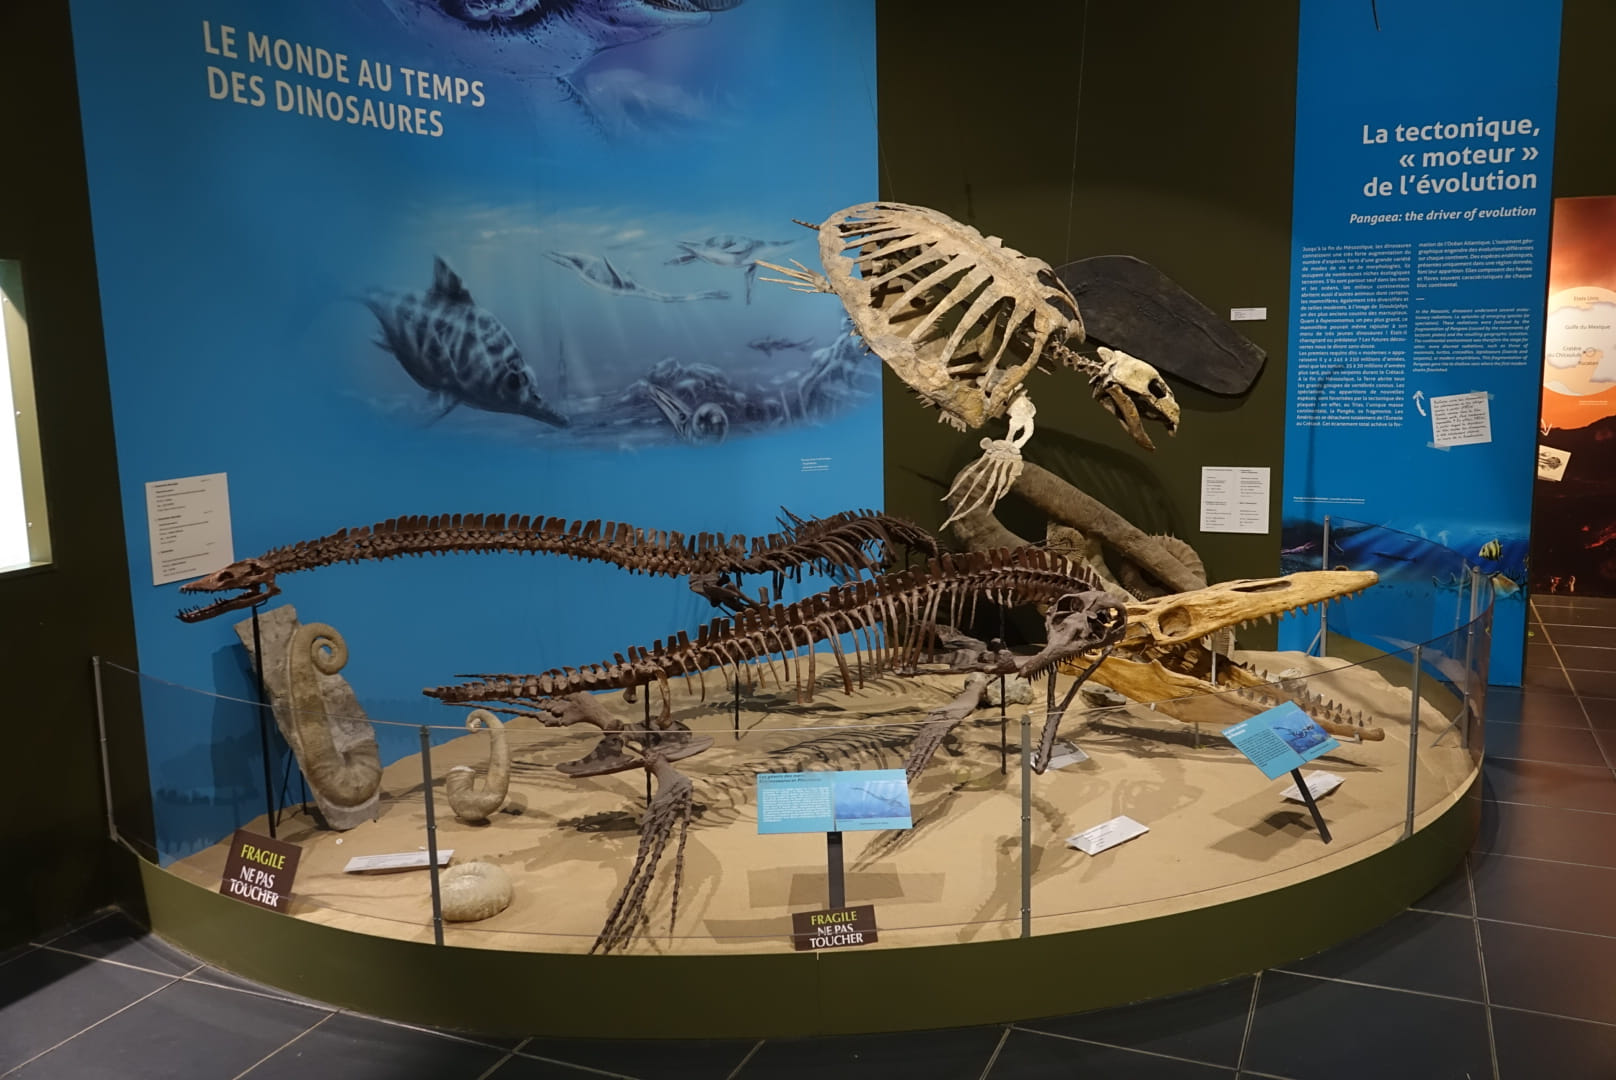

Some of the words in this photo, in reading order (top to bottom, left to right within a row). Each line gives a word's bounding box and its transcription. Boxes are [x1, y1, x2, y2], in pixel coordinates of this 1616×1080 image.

[202, 20, 238, 59] LE
[248, 31, 350, 83] MONDE
[359, 61, 392, 91] AU
[400, 69, 485, 107] TEMPS
[207, 66, 266, 107] DES
[275, 79, 443, 137] DINOSAURES
[1363, 124, 1388, 145] La
[1395, 116, 1540, 143] tectonique,
[1422, 147, 1516, 168] moteur
[1363, 176, 1393, 197] de
[1400, 169, 1537, 195] l'évolution
[1349, 213, 1402, 226] Pangaea:
[1405, 211, 1424, 221] the
[1426, 210, 1462, 220] driver
[1463, 208, 1478, 221] of
[1478, 206, 1537, 218] evolution
[240, 843, 287, 870] FRAGILE
[239, 865, 257, 883] NE
[254, 869, 276, 889] PAS
[229, 878, 280, 908] TOUCHER
[810, 910, 858, 926] FRAGILE
[817, 925, 833, 937] NE
[834, 923, 855, 935] PAS
[808, 932, 864, 949] TOUCHER
